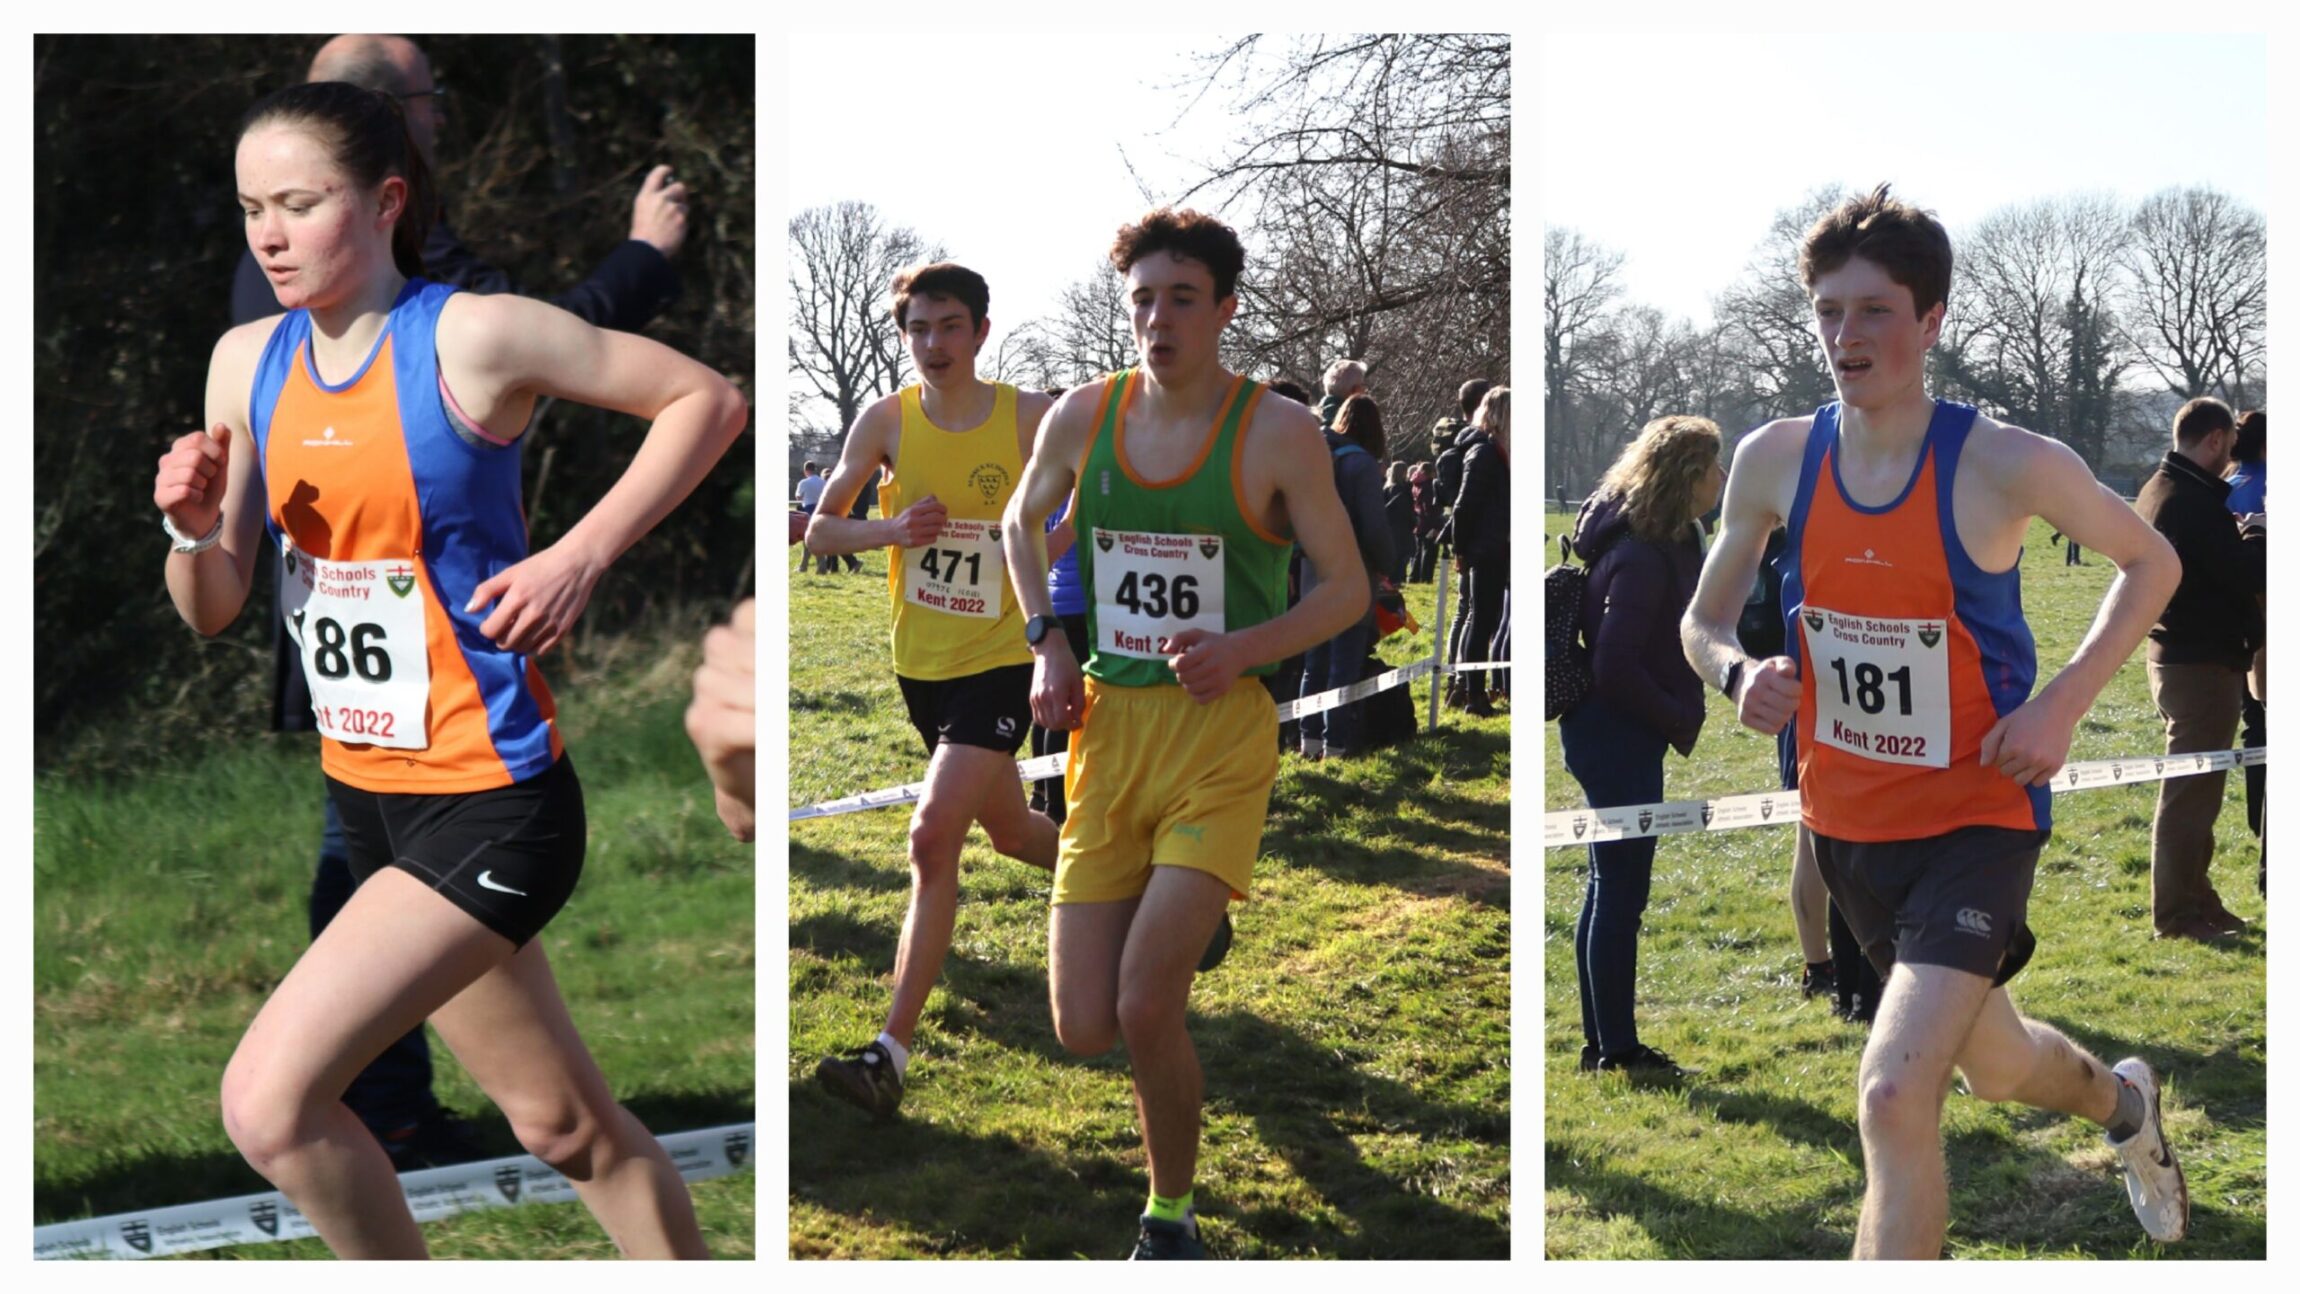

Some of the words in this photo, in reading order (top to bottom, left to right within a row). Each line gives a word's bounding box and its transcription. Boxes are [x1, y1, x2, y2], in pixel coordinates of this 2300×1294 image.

[951, 530, 980, 541] Country
[955, 521, 985, 531] Schools
[1119, 533, 1152, 545] English
[1154, 535, 1193, 547] Schools
[1124, 544, 1149, 556] Cross
[1151, 547, 1188, 560] Country
[321, 565, 376, 581] Schools
[920, 547, 981, 585] 471
[319, 582, 370, 600] Country
[918, 587, 946, 608] Kent
[950, 596, 985, 613] 2022
[1116, 571, 1199, 619] 436
[1828, 613, 1862, 630] English
[1866, 620, 1910, 633] Schools
[1115, 629, 1151, 653] Kent
[1833, 627, 1859, 643] Cross
[1862, 633, 1905, 648] Country
[1831, 657, 1912, 715] 181
[339, 707, 395, 737] 2022
[1833, 719, 1869, 751] Kent
[1874, 734, 1926, 757] 2022
